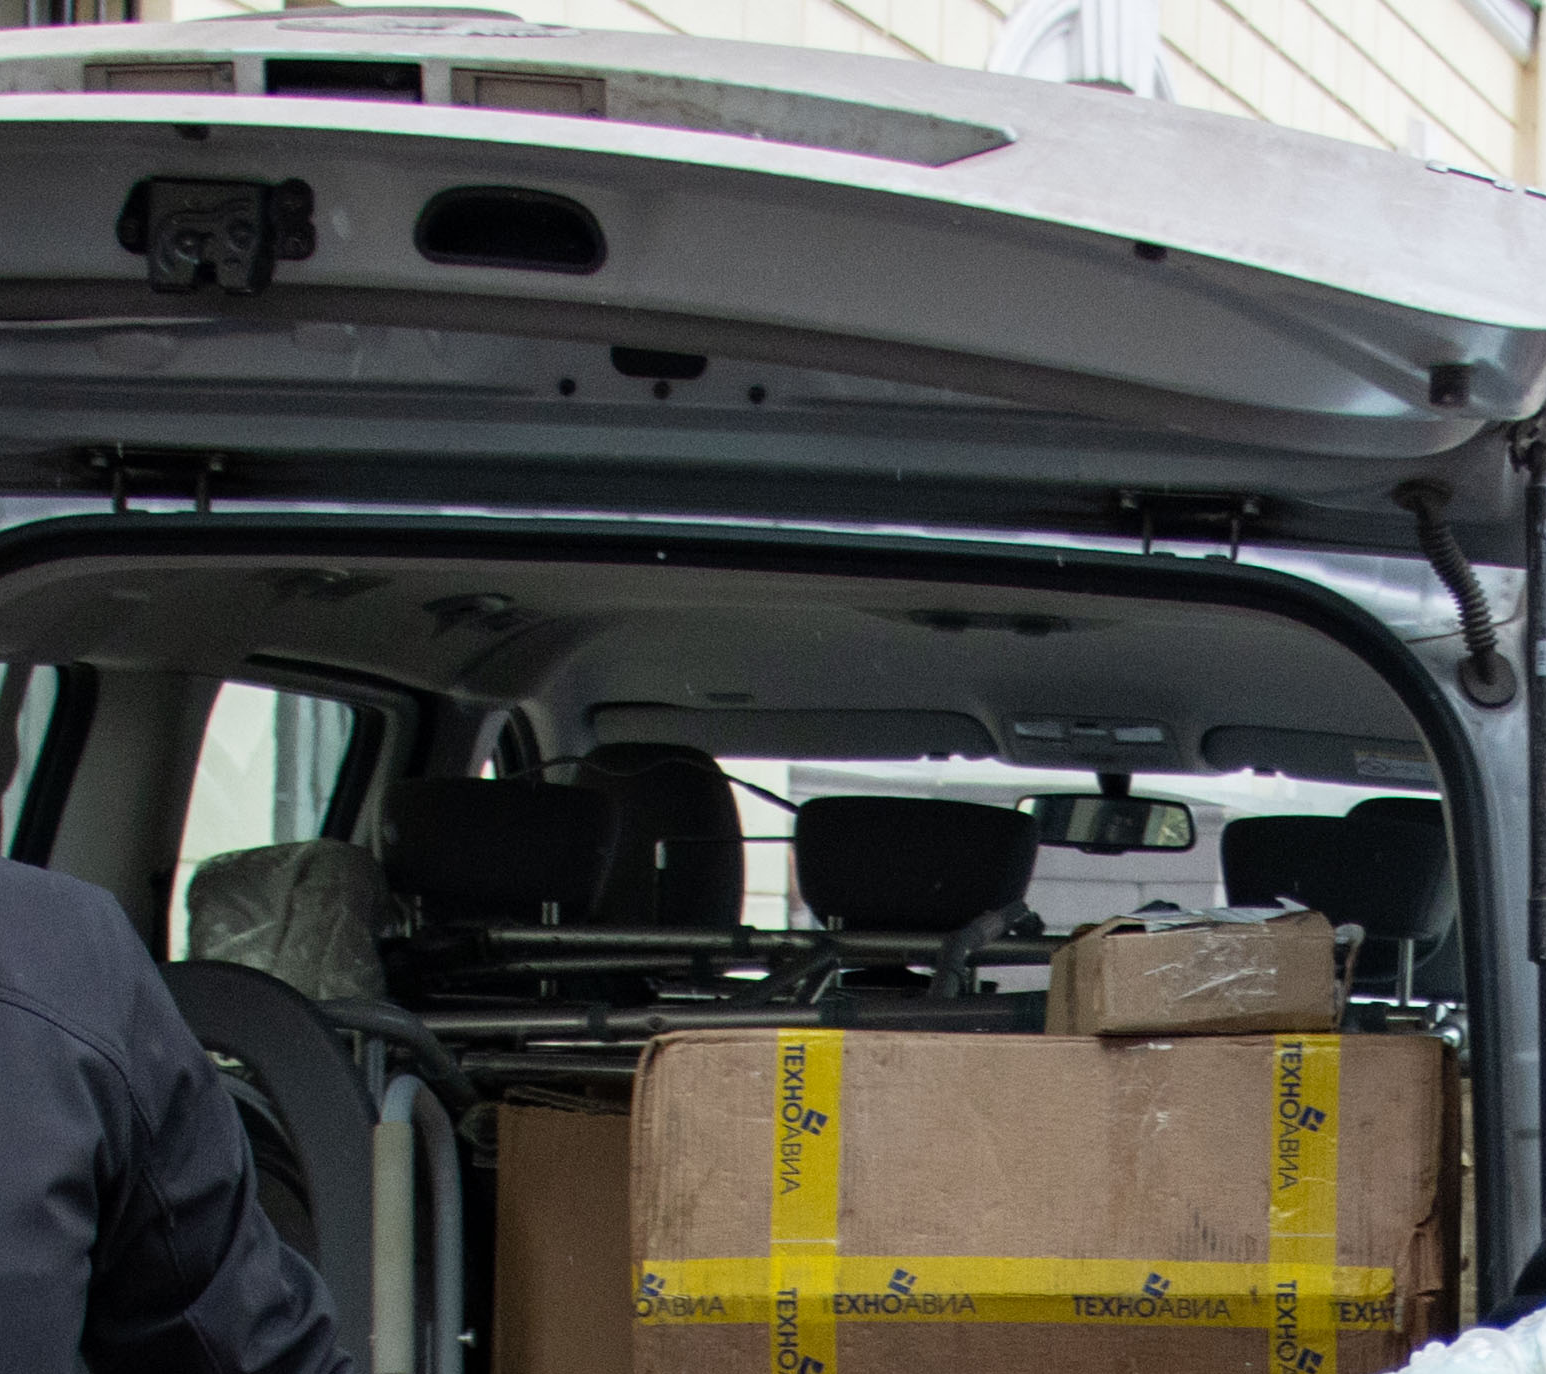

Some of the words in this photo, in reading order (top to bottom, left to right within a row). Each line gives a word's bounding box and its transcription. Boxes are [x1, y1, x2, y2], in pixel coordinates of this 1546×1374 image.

[780, 1044, 805, 1195] ТЕХНОАВИА
[1277, 1041, 1303, 1191] ТЕХНОАВИА
[1072, 1295, 1232, 1320] ТЕХНОАВИА
